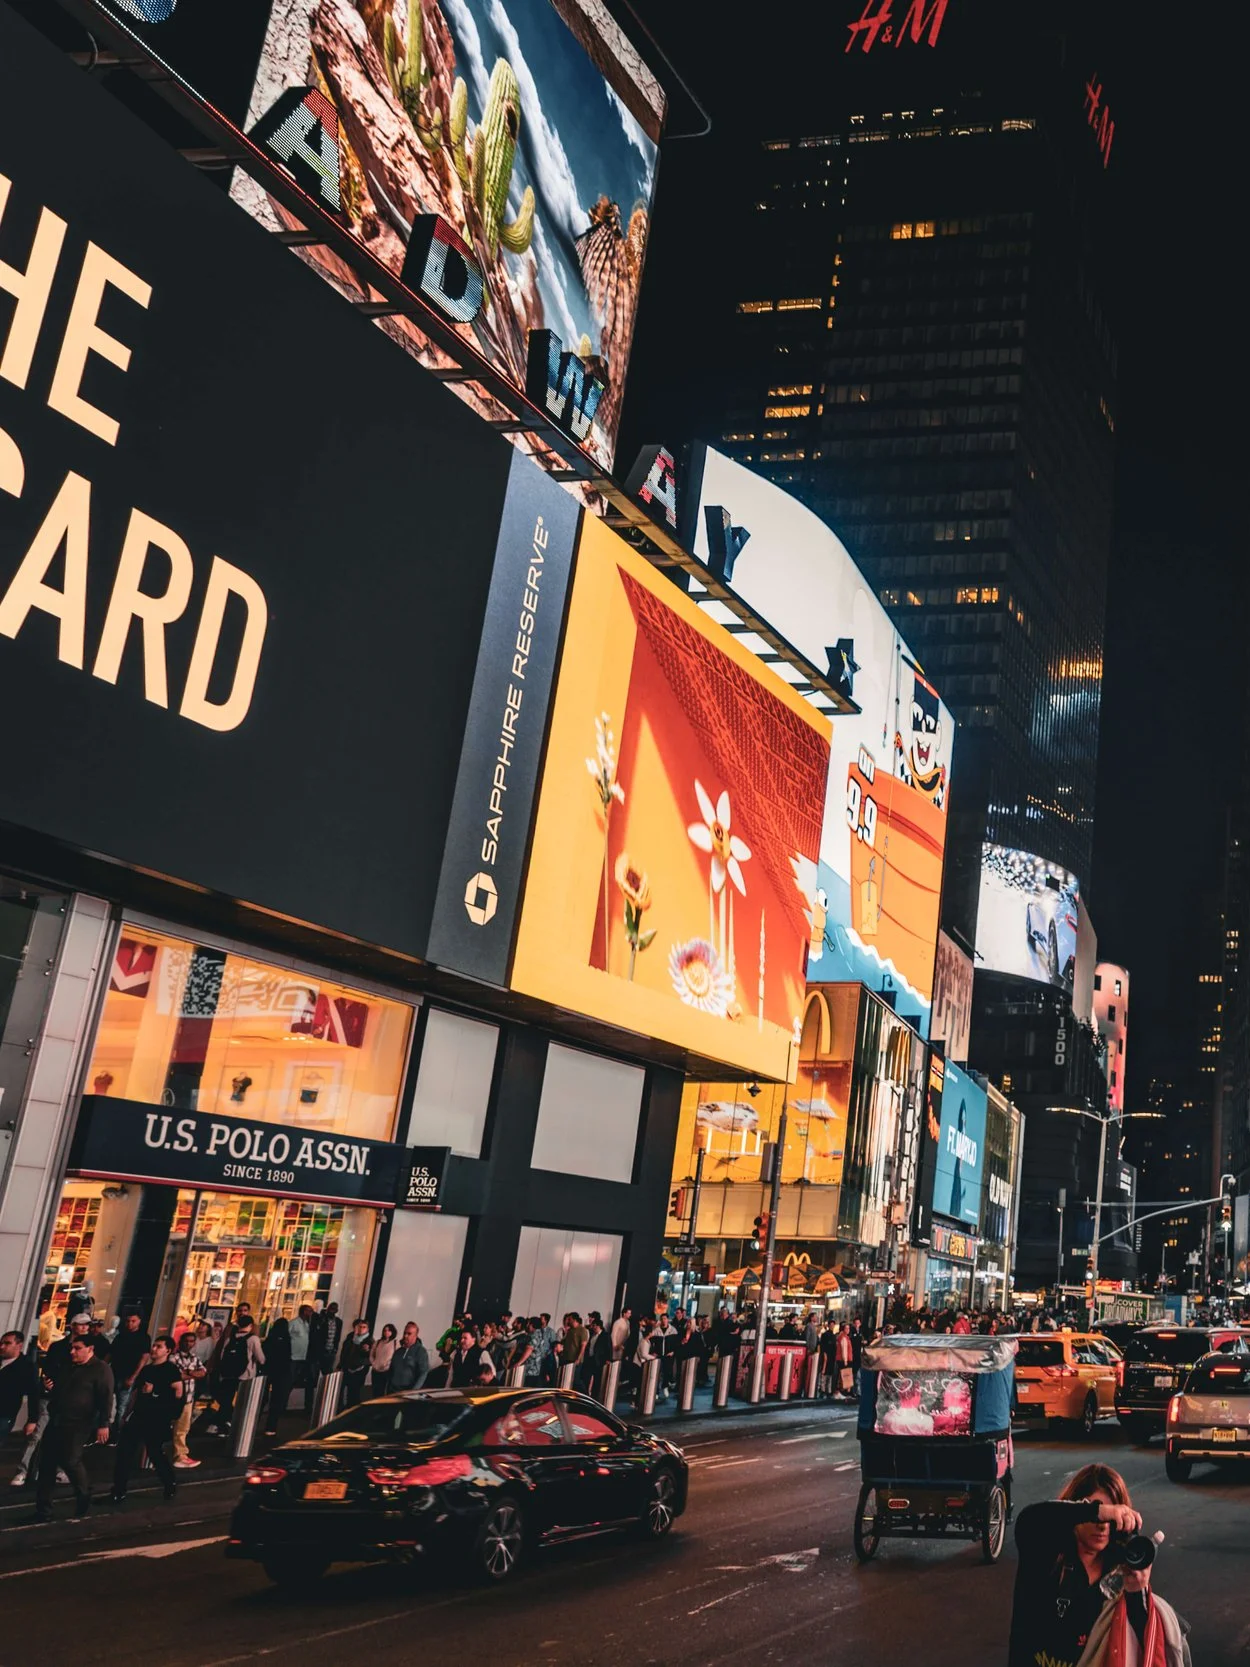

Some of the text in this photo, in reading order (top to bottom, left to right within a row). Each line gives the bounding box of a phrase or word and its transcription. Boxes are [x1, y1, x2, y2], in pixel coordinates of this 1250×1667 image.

[846, 0, 948, 54] H&M
[481, 683, 523, 865] SAPPHIRE
[847, 775, 878, 849] 9.9
[1054, 1016, 1067, 1066] 1500
[144, 1113, 371, 1176] U.S. POLO ASSN.
[223, 1163, 295, 1184] SINCE 1890
[407, 1187, 437, 1198] ASSN.
[409, 1177, 437, 1187] POLO
[411, 1166, 430, 1177] U.S.
